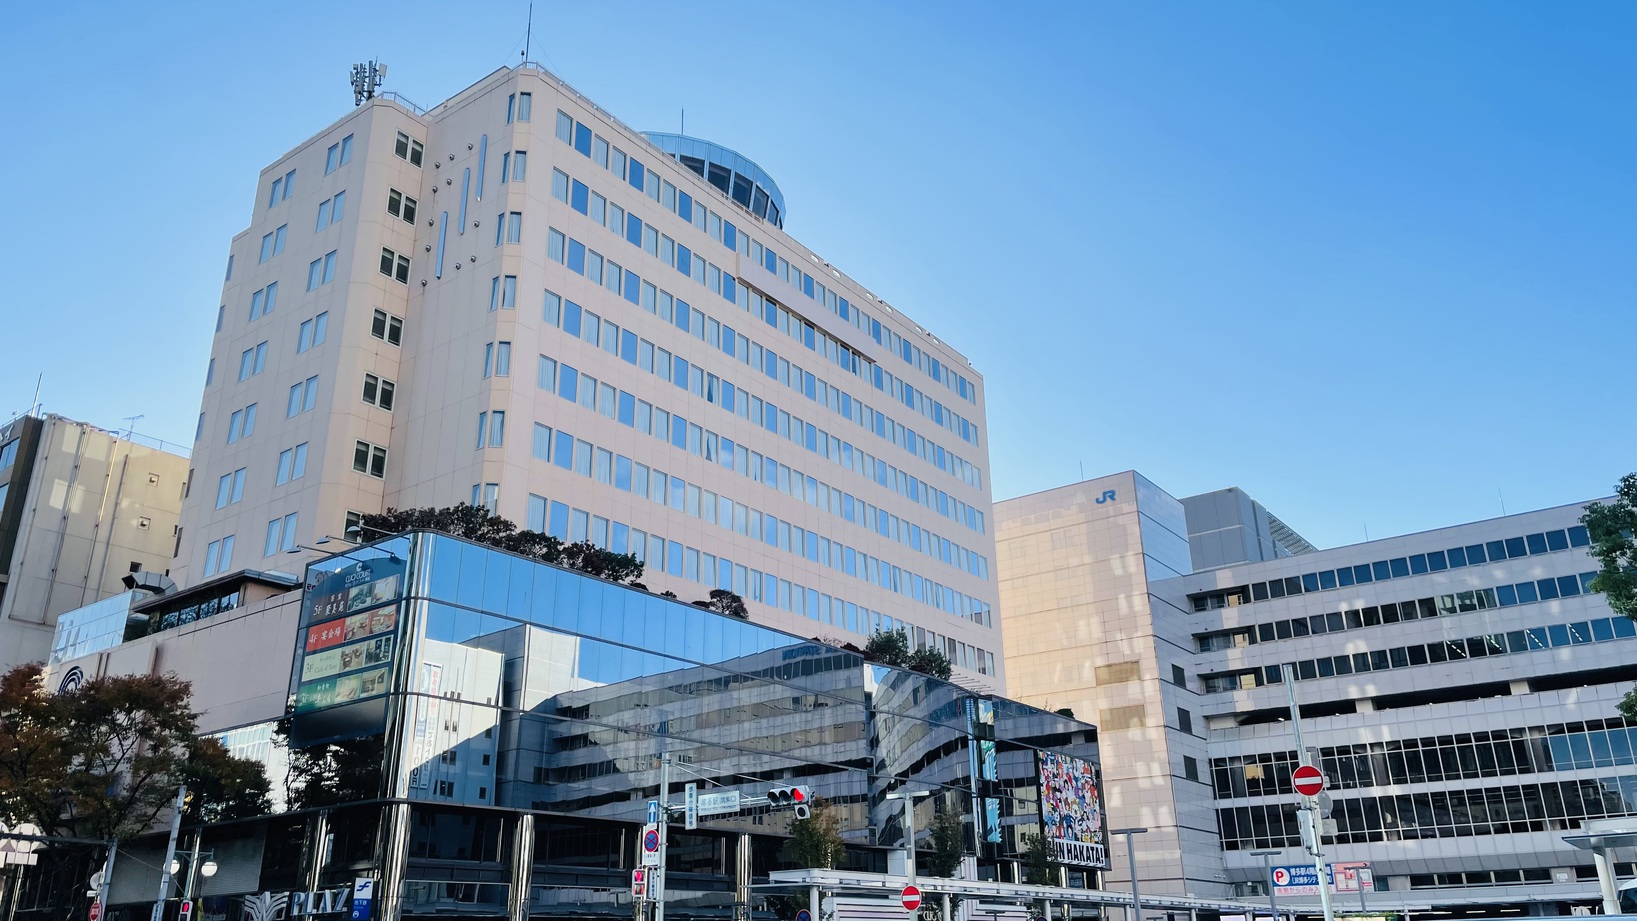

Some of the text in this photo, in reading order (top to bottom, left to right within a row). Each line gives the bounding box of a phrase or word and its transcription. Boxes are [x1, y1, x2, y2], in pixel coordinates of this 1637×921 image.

[1095, 489, 1117, 504] JR
[1066, 842, 1104, 864] HAKATA!
[1275, 870, 1284, 883] P
